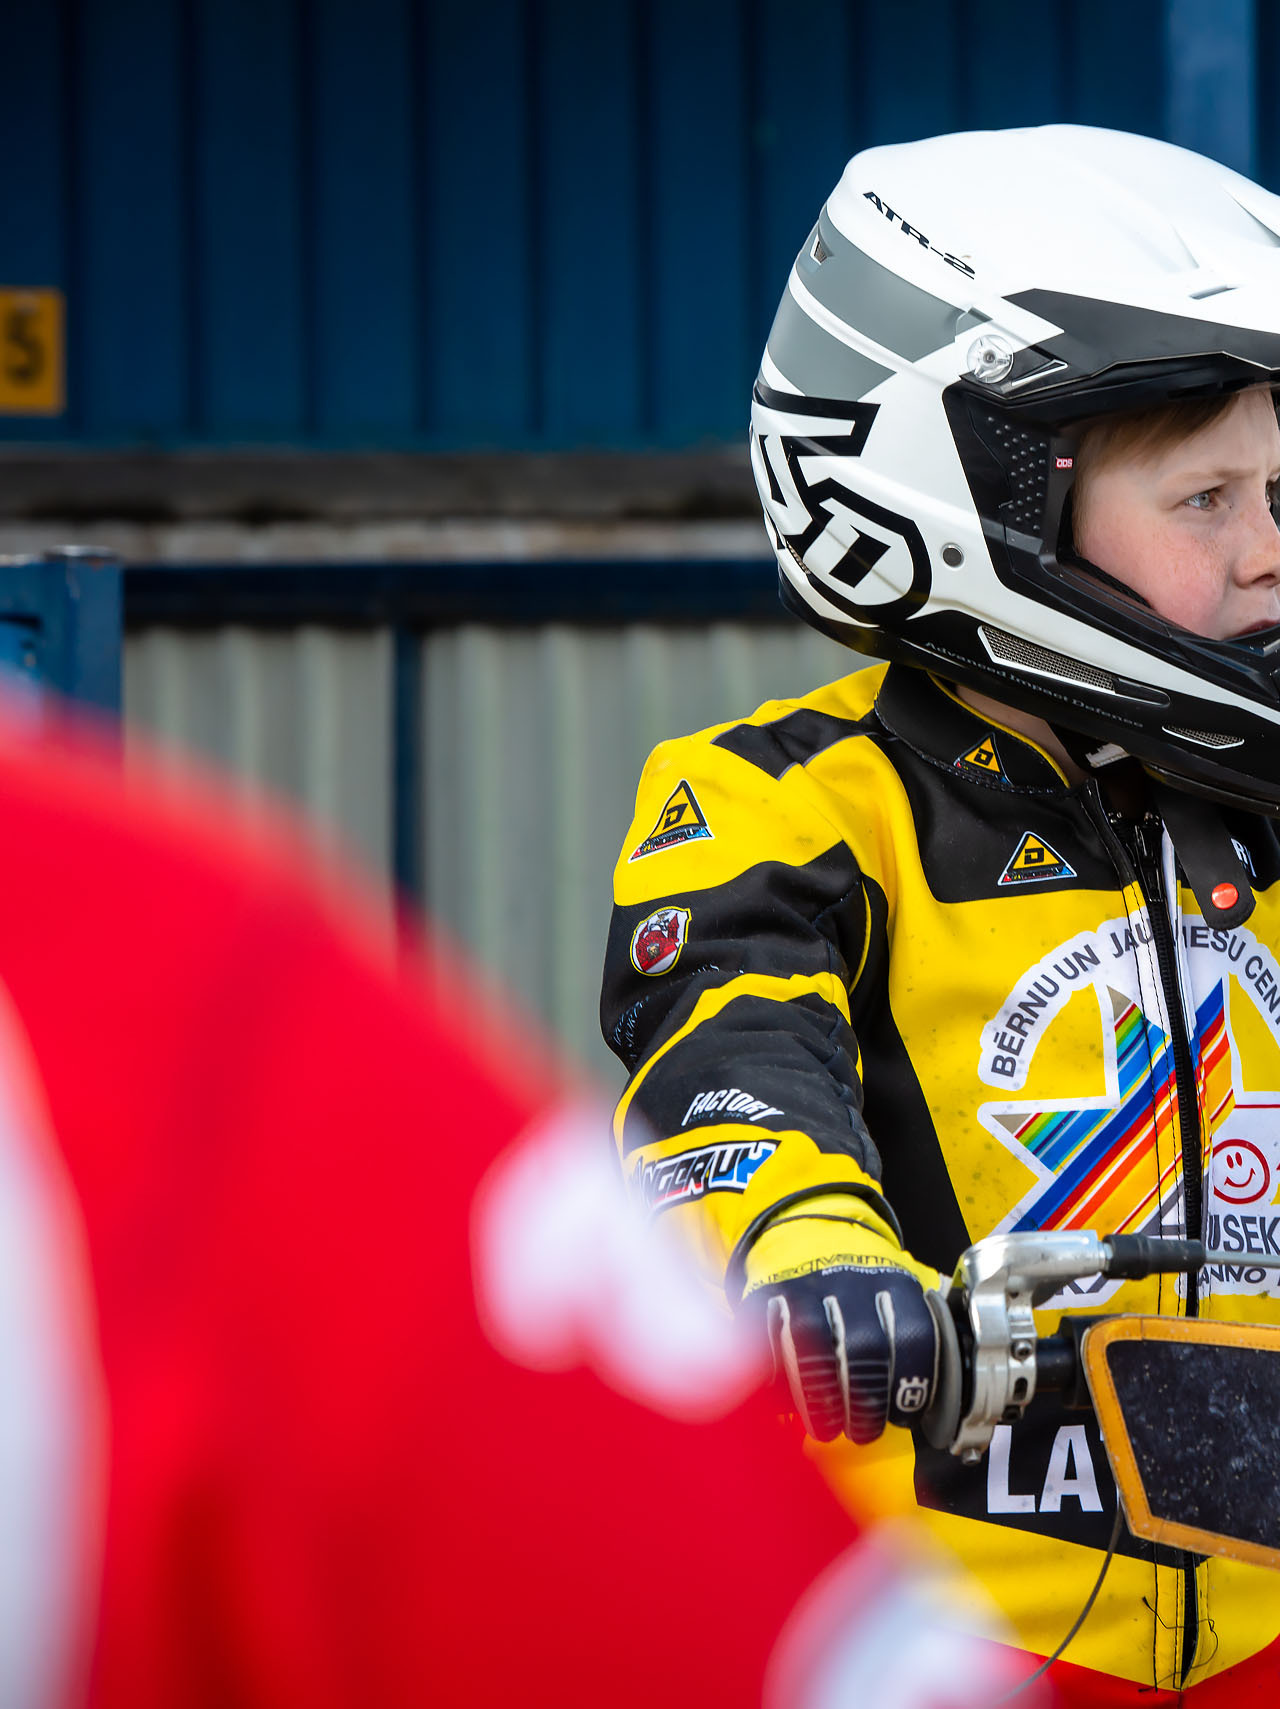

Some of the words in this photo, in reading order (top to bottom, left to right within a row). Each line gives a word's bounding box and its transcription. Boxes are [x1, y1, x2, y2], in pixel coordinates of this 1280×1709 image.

[862, 190, 976, 281] ATR-2
[925, 641, 1007, 677] Advanced
[1009, 674, 1068, 701] Impact
[990, 981, 1061, 1078] BĒRNU
[1057, 943, 1101, 981] UN
[681, 1088, 785, 1127] FACTORY
[1198, 1264, 1267, 1285] ANNO
[986, 1424, 1106, 1514] LA
